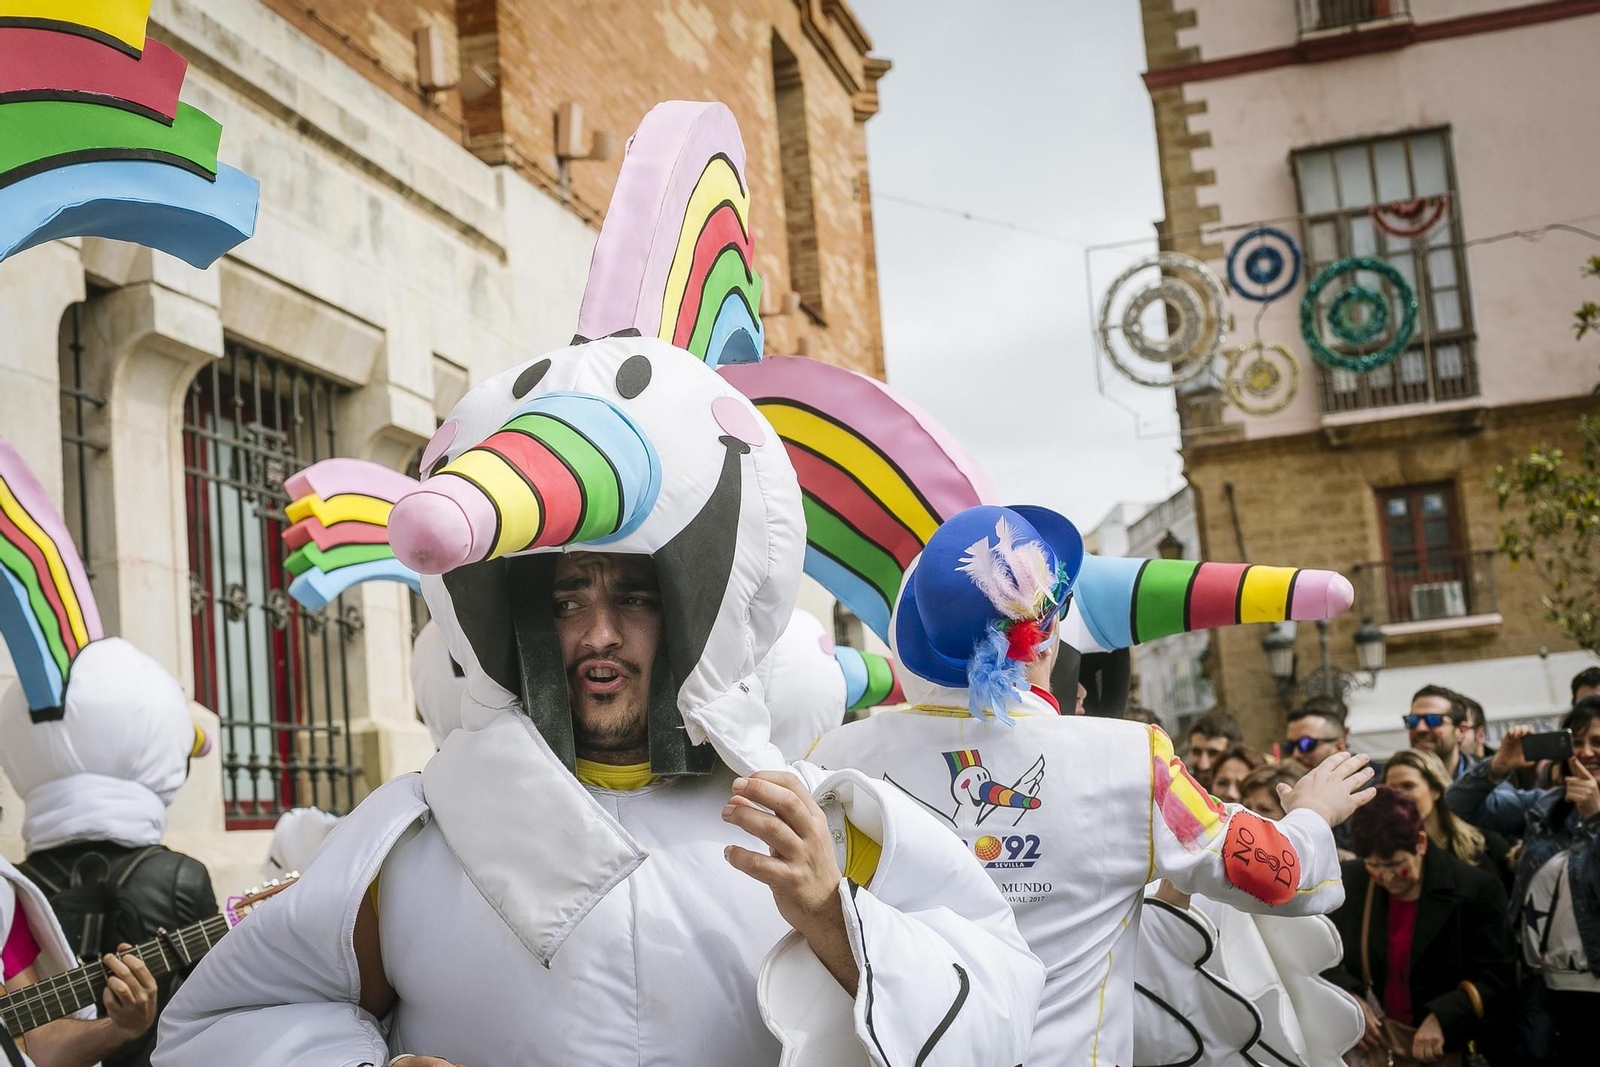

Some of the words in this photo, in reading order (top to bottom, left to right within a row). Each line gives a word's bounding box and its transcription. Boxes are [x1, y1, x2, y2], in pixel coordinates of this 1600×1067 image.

[1231, 827, 1255, 867] NO
[1001, 882, 1052, 893] MUNDO
[1273, 850, 1296, 889] DO
